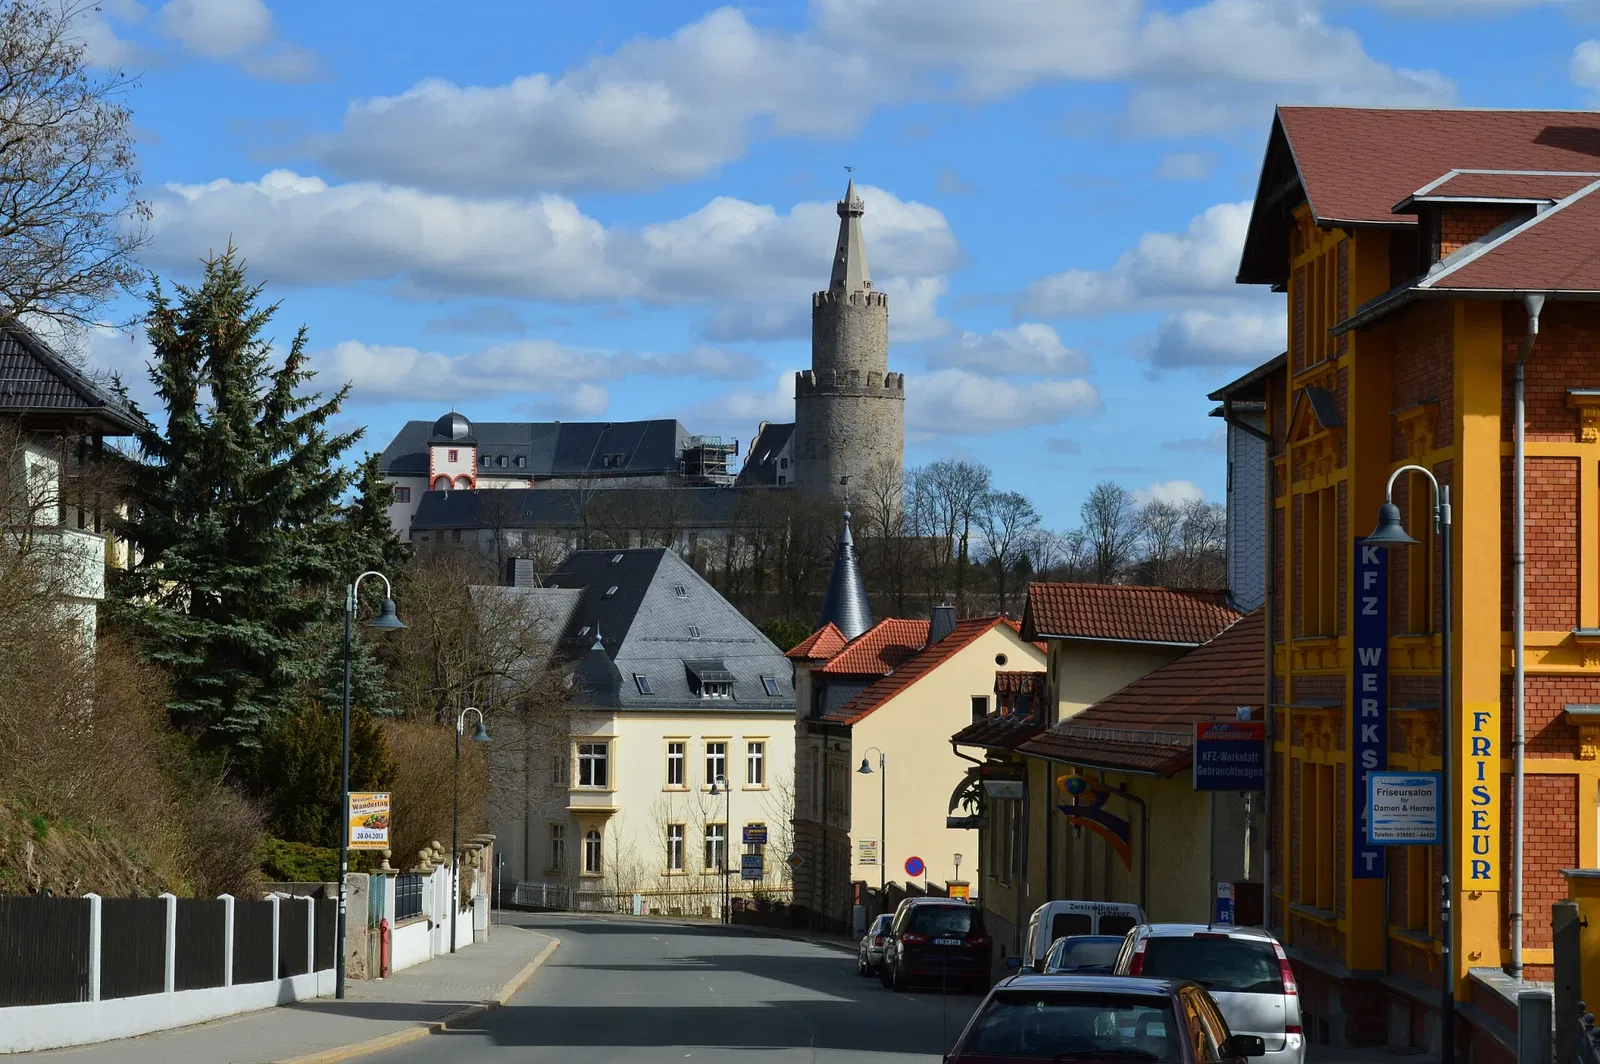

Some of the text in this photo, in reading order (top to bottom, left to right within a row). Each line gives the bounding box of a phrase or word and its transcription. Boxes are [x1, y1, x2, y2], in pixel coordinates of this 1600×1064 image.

[1361, 545, 1380, 615] KFZ
[1202, 751, 1259, 763] KFZ-Werkstatt
[1197, 765, 1263, 778] Gebrauchtwagen
[1376, 788, 1432, 796] Friseursalon
[1471, 712, 1492, 879] FRISEUR
[352, 800, 388, 810] Wandertag
[1070, 903, 1119, 911] Zweiradhaus
